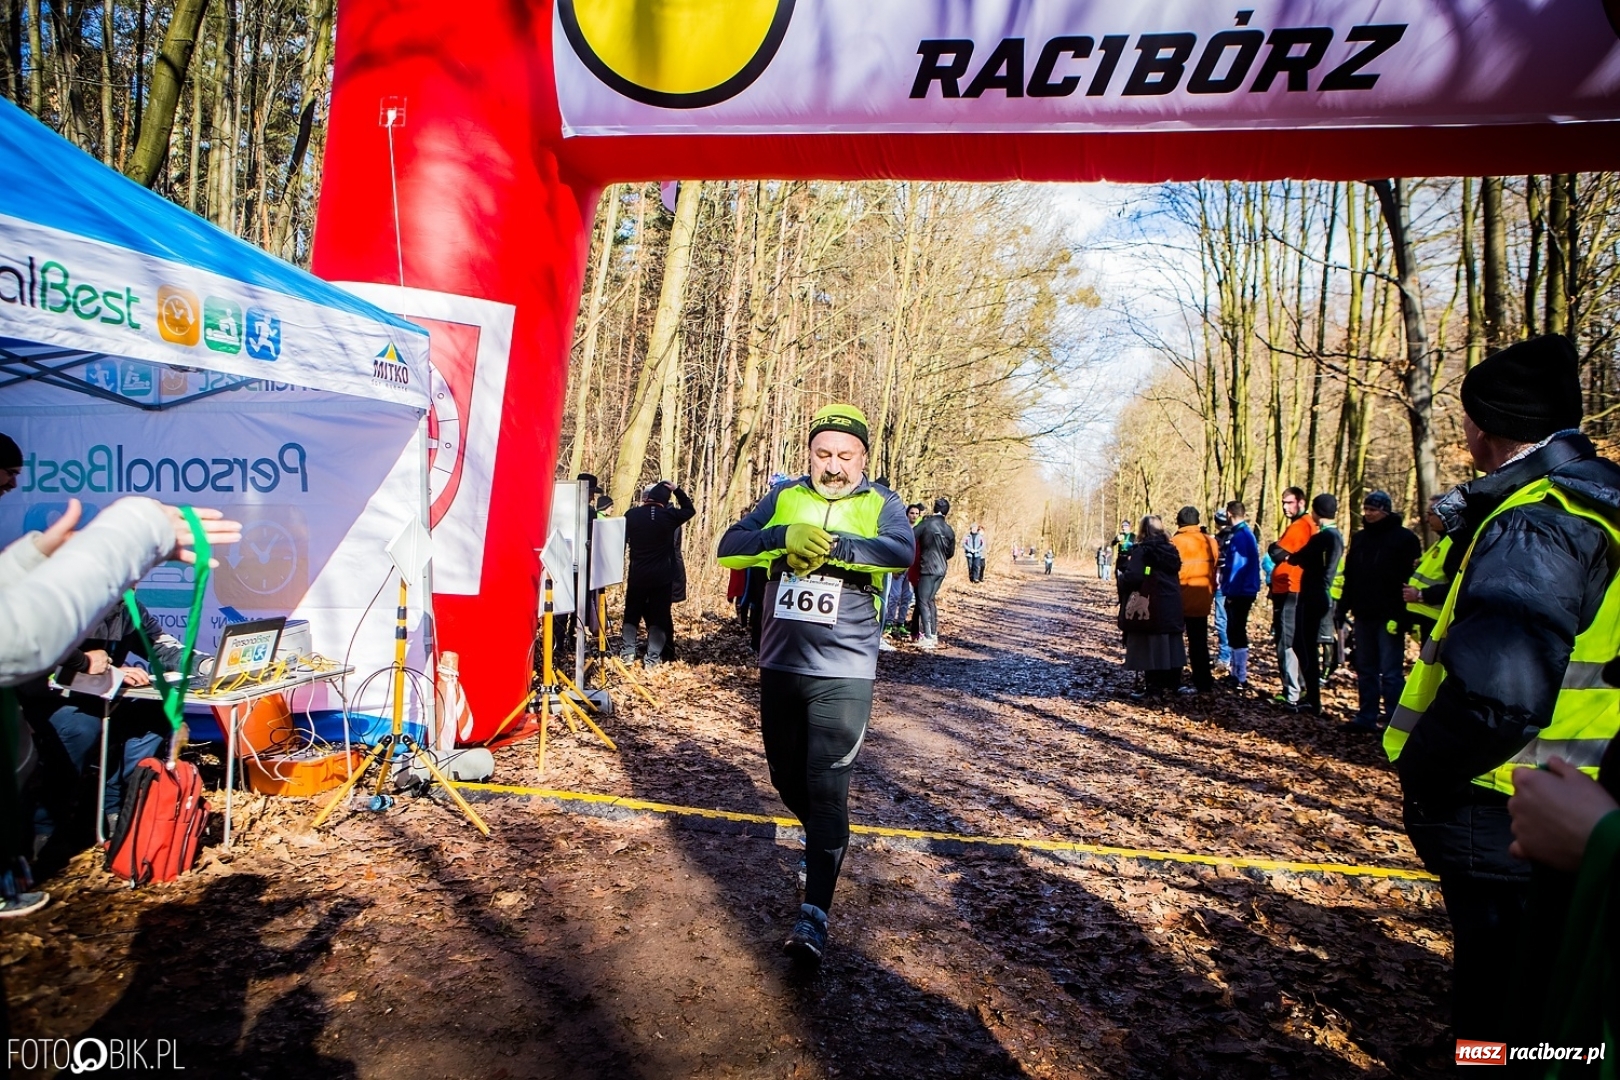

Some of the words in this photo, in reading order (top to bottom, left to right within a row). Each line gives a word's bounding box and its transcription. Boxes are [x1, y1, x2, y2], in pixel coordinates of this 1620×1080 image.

[909, 10, 1409, 99] RACIBÓRZ
[373, 359, 409, 384] MITKO
[778, 588, 835, 615] 466
